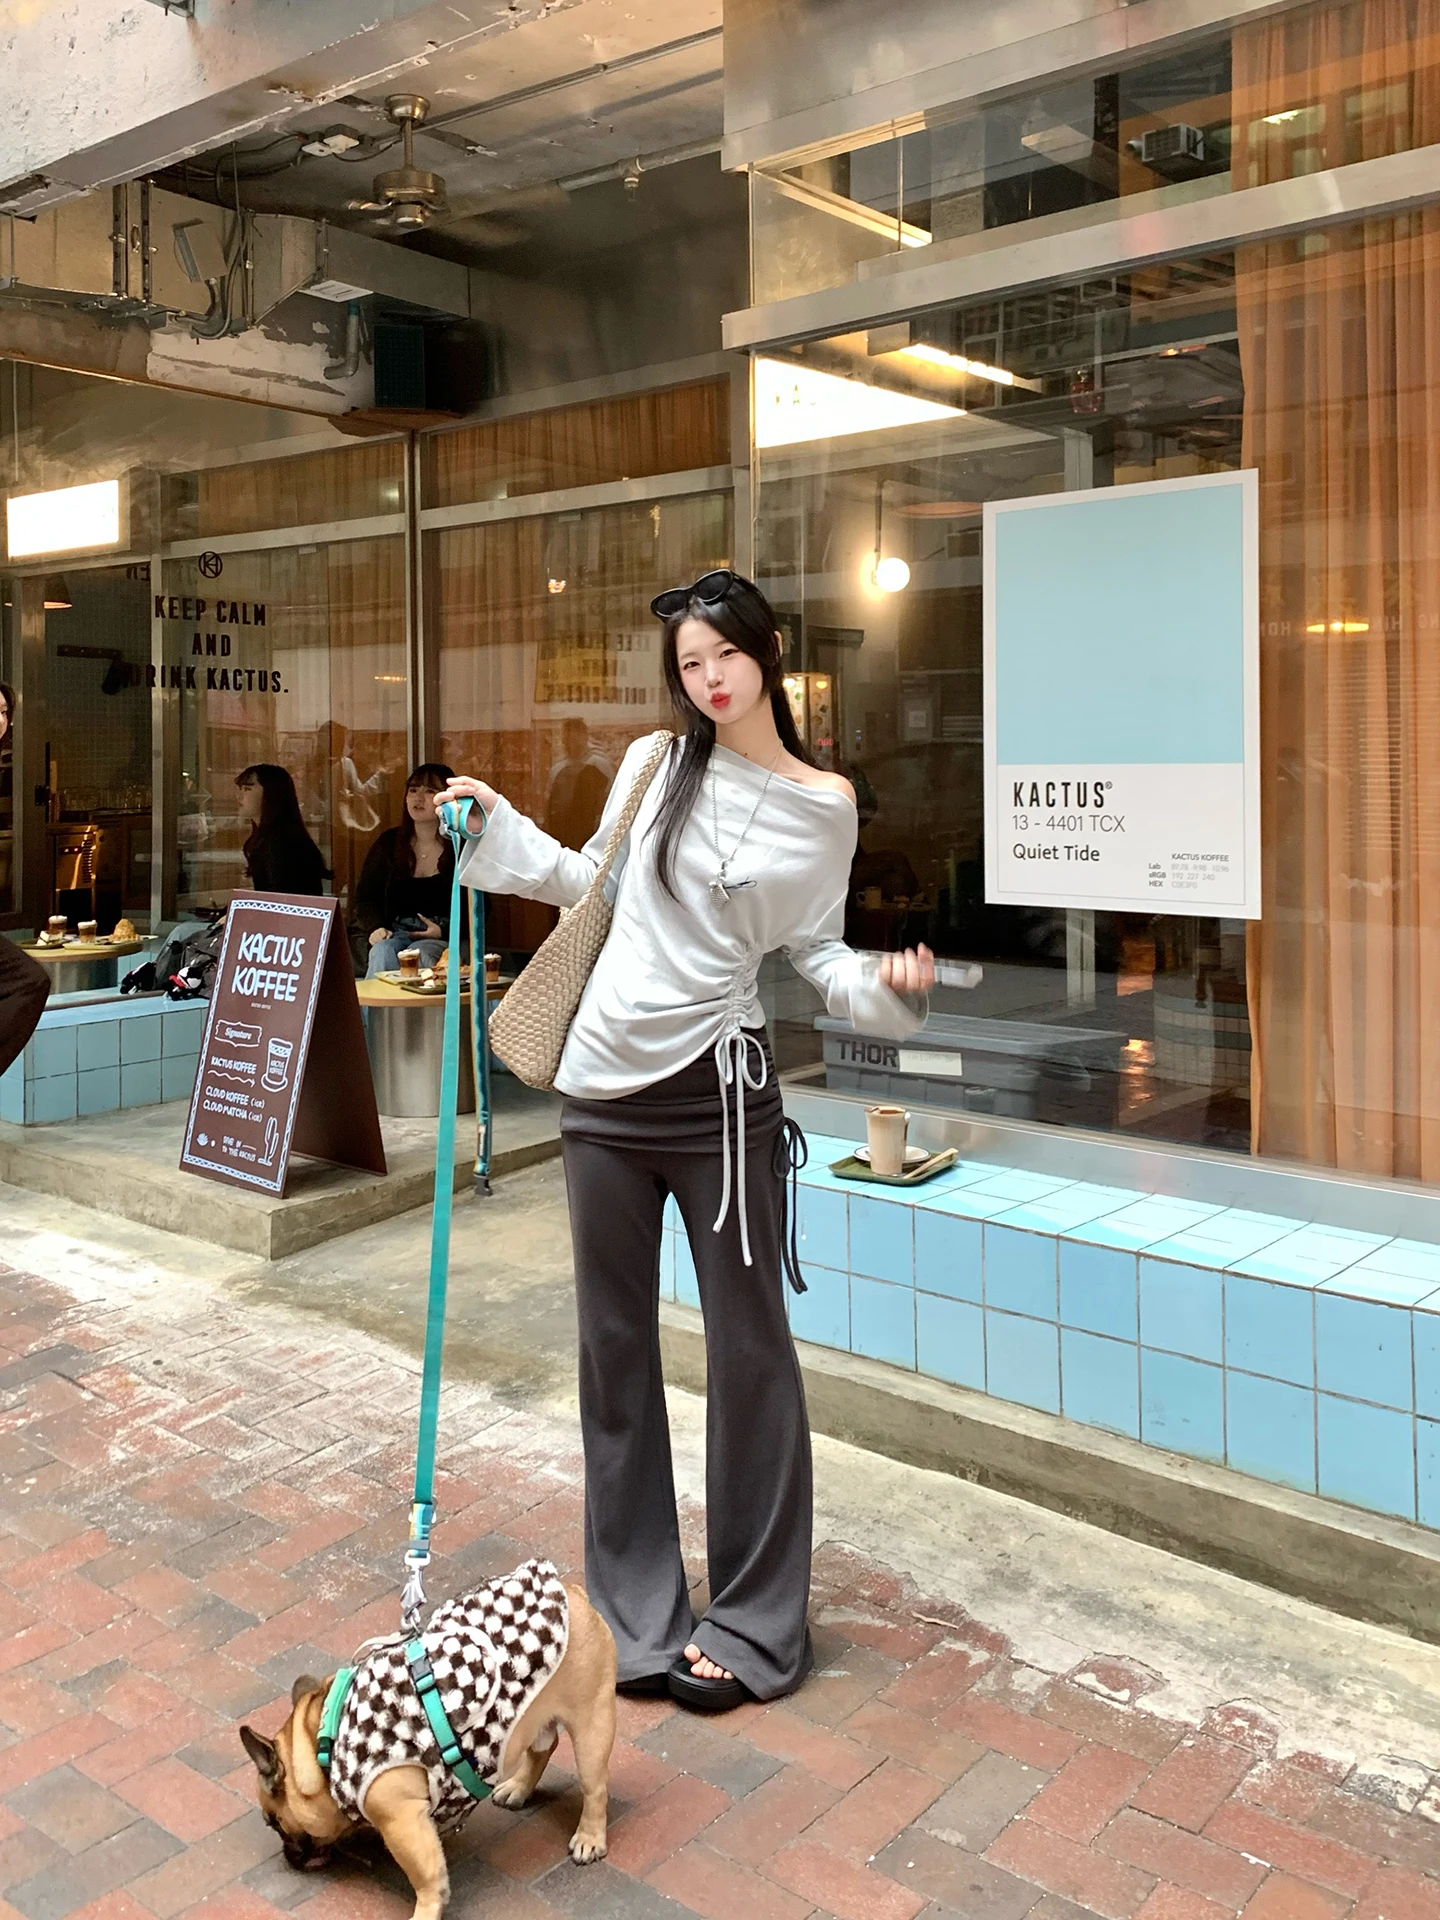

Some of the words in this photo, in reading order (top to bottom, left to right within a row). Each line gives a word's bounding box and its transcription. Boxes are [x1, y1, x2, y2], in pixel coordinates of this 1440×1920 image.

[154, 595, 206, 621] KEEP
[216, 600, 266, 626] CALM
[192, 633, 231, 657] AND
[207, 667, 289, 693] KACTUS.
[1012, 814, 1029, 831] 13
[1046, 815, 1084, 832] 4401
[1089, 815, 1126, 833] TCX
[1012, 843, 1059, 861] Quiet
[1063, 845, 1100, 862] Tide
[1171, 853, 1200, 861] KACTUS
[1200, 854, 1229, 862] KOFFEE
[1148, 871, 1166, 879] sRGB
[1148, 880, 1163, 888] HEX
[237, 931, 306, 968] KACTUS
[231, 965, 300, 1003] KOFFEE
[835, 1039, 899, 1069] THOR
[211, 1055, 233, 1070] KACTUS
[232, 1060, 257, 1075] KOFFEE
[205, 1085, 226, 1099] CLOUD
[225, 1091, 250, 1106] KOFFEE
[203, 1099, 223, 1113] CLOUD
[222, 1105, 247, 1120] MATCHA
